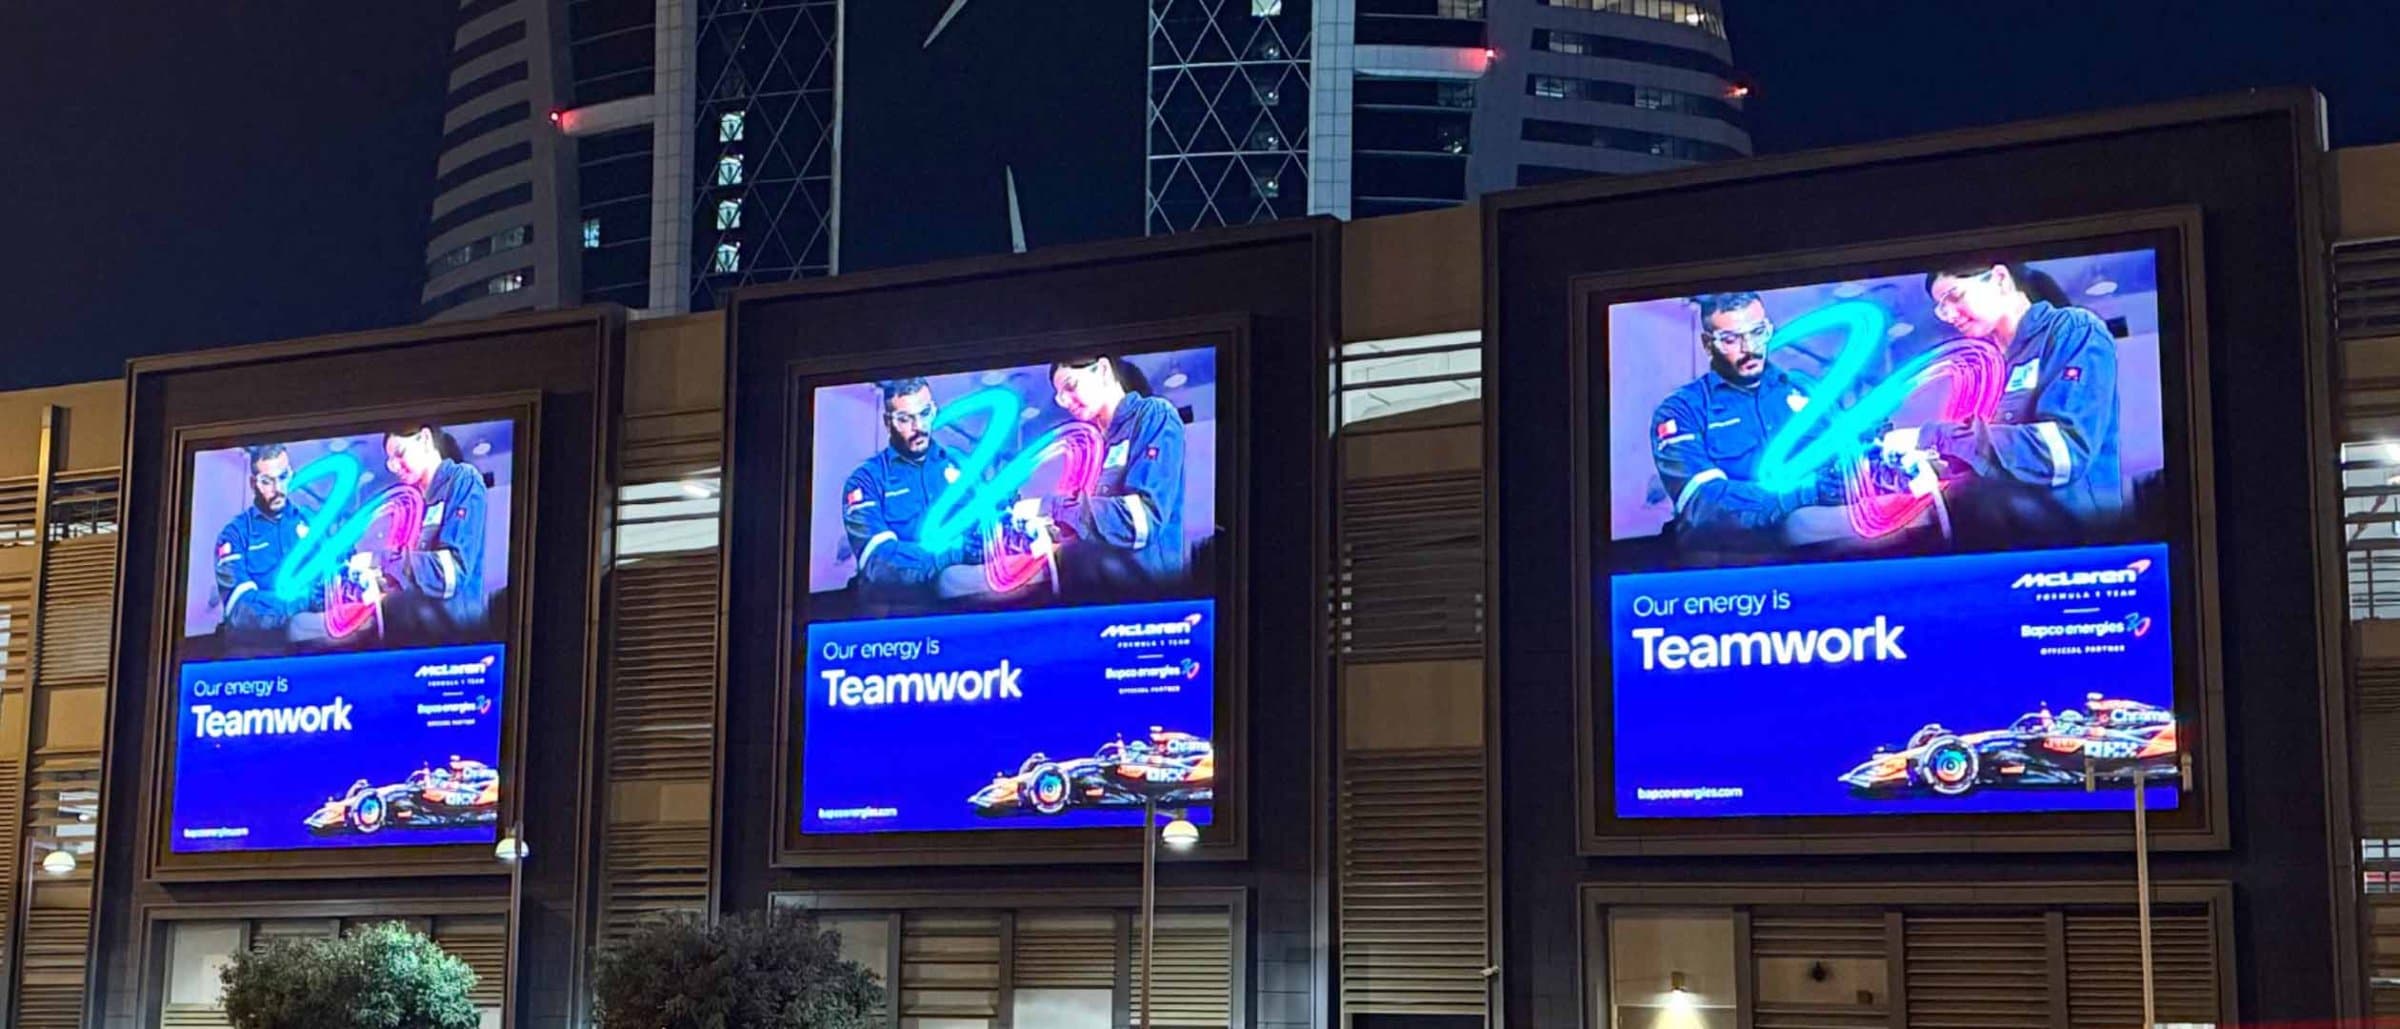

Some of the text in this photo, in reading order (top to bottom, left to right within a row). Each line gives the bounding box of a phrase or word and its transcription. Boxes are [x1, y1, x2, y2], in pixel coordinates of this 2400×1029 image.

[2011, 567, 2138, 588] McLaren
[1633, 589, 1791, 617] Our energy is
[2035, 590, 2090, 601] FORMULA
[2106, 588, 2137, 598] TEAM
[1100, 621, 1192, 638] McLaren
[2021, 620, 2125, 639] Bapco energies
[823, 636, 940, 660] Our energy is
[1632, 615, 1907, 670] Teamwork
[2040, 645, 2083, 656] OFFICIAL
[414, 663, 487, 678] McLaren
[194, 675, 288, 697] Our energy is
[821, 659, 1023, 707] Teamwork
[191, 696, 353, 738] Teamwork
